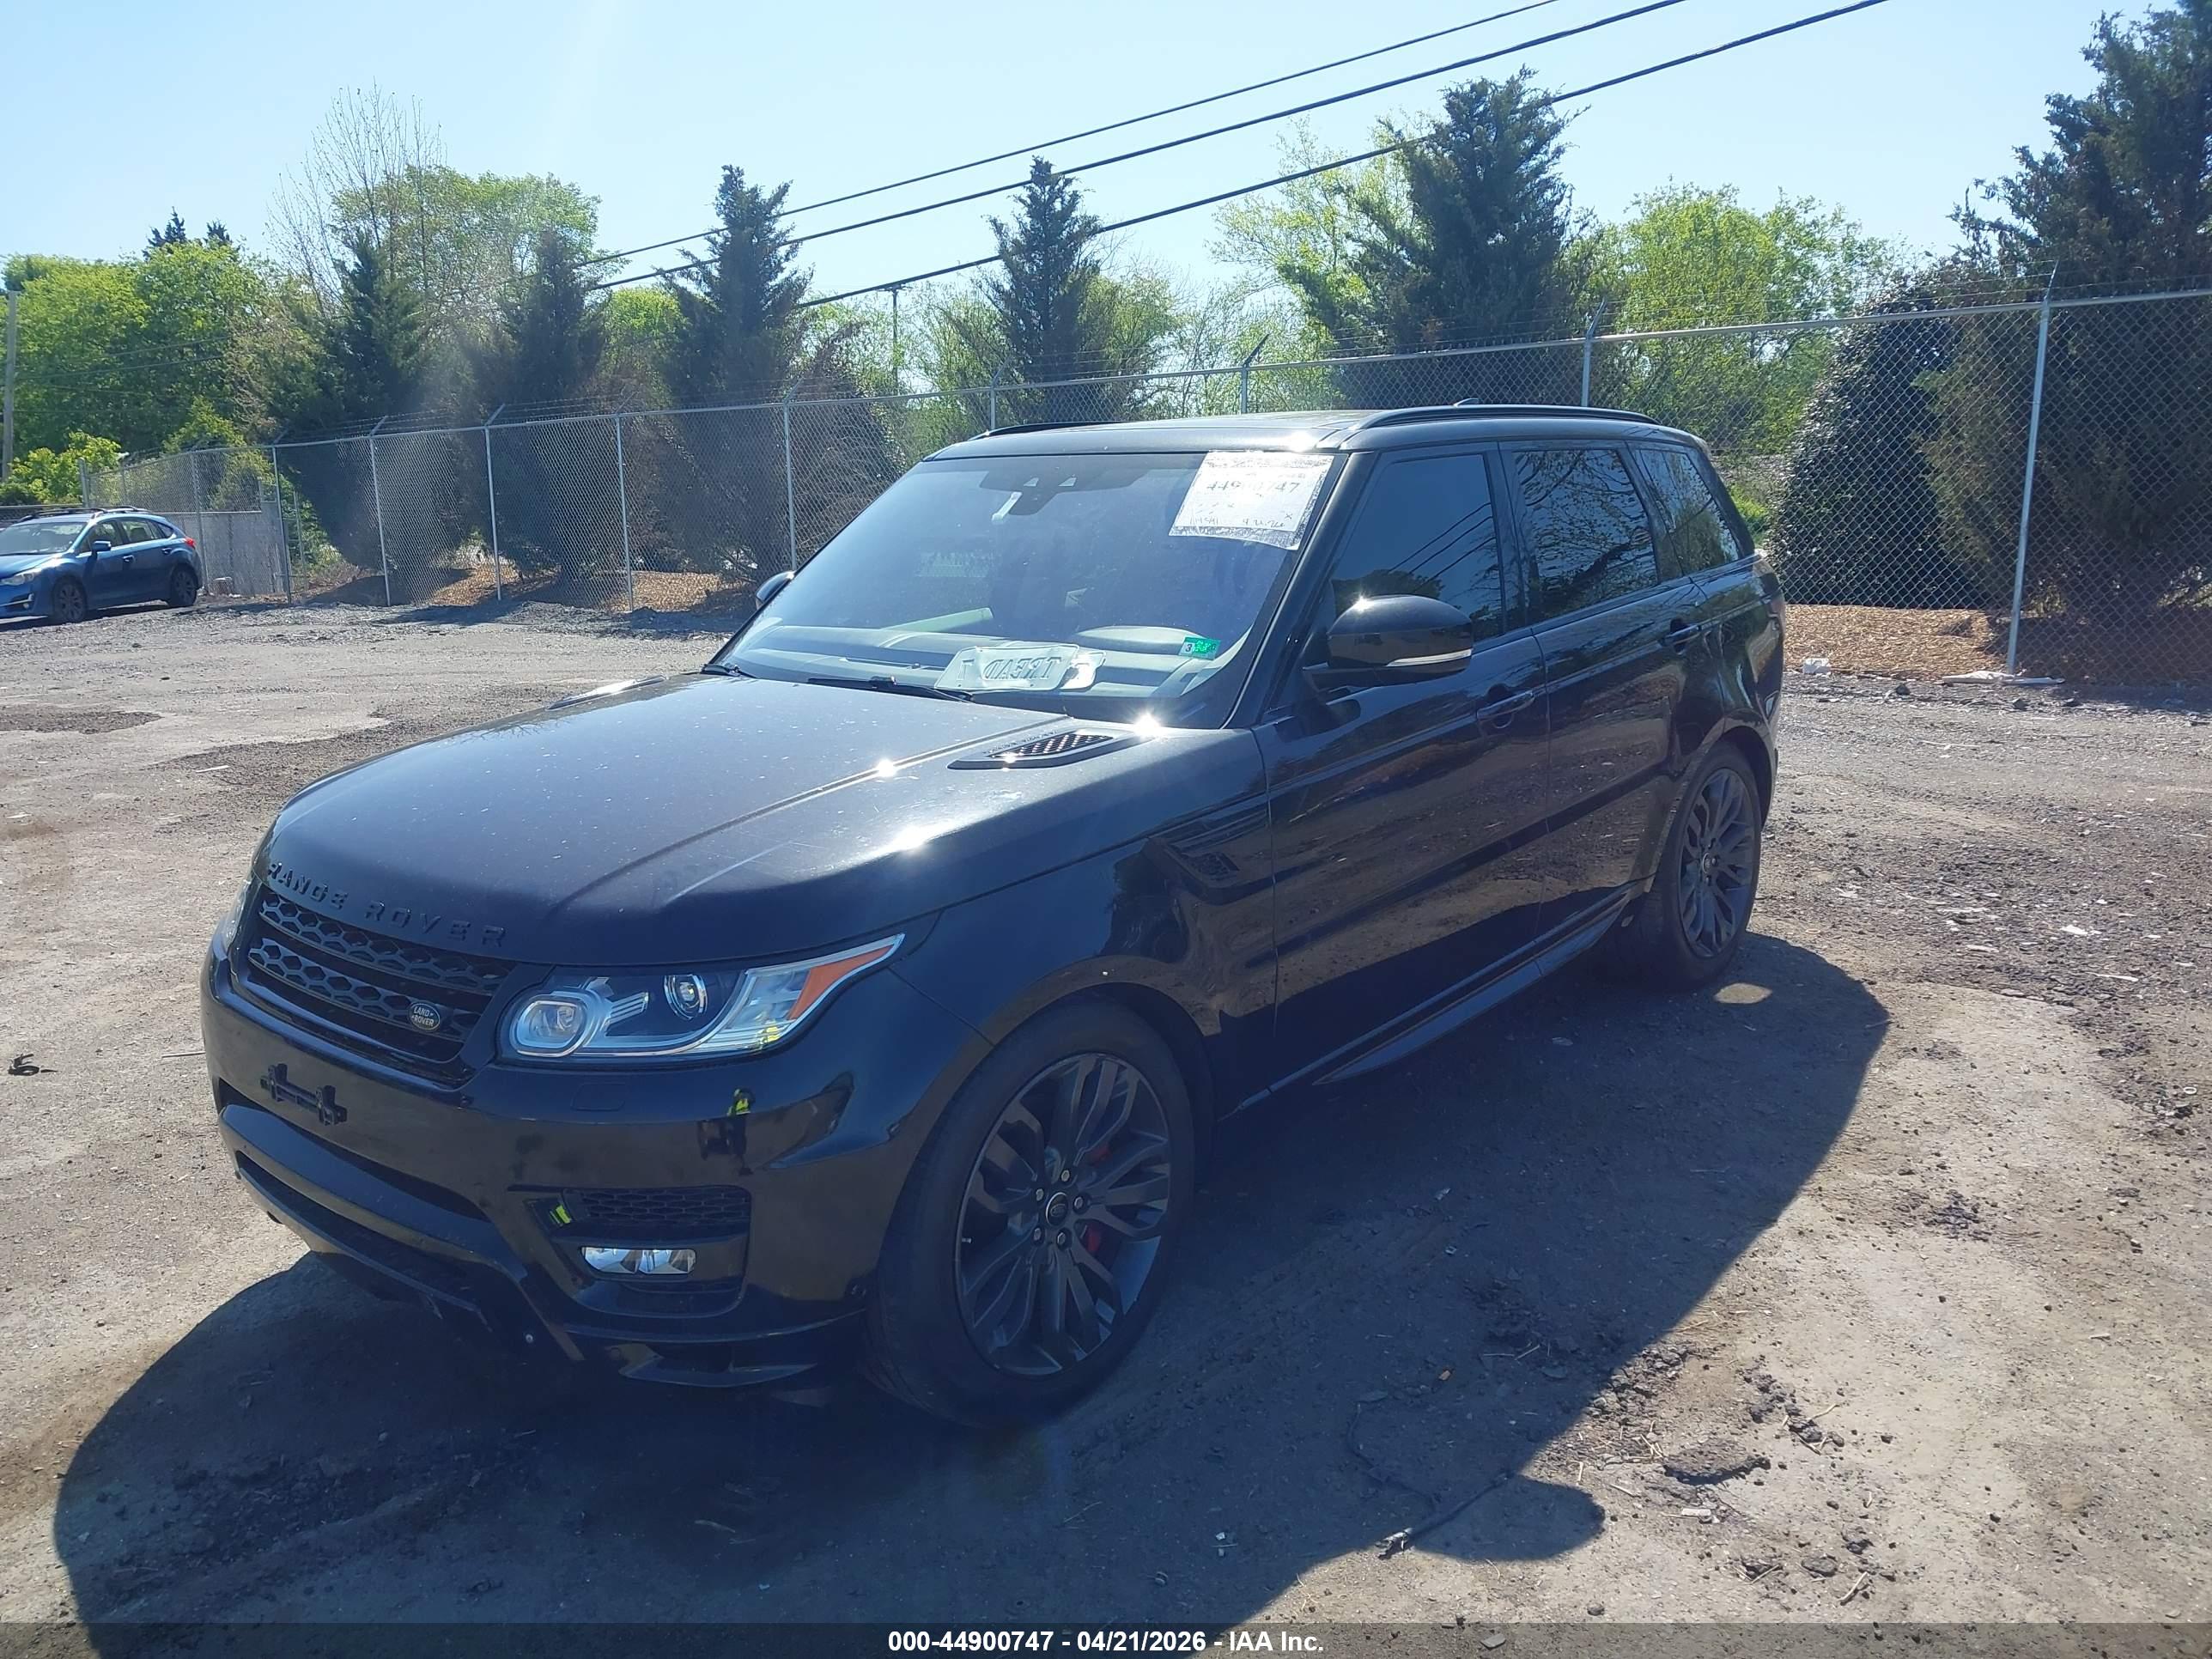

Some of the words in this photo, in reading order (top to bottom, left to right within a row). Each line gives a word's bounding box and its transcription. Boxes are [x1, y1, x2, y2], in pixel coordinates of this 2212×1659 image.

[267, 862, 349, 910] RANGE
[364, 900, 507, 948] ROVER
[413, 1006, 430, 1017] LAND
[414, 1015, 434, 1027] ROVER
